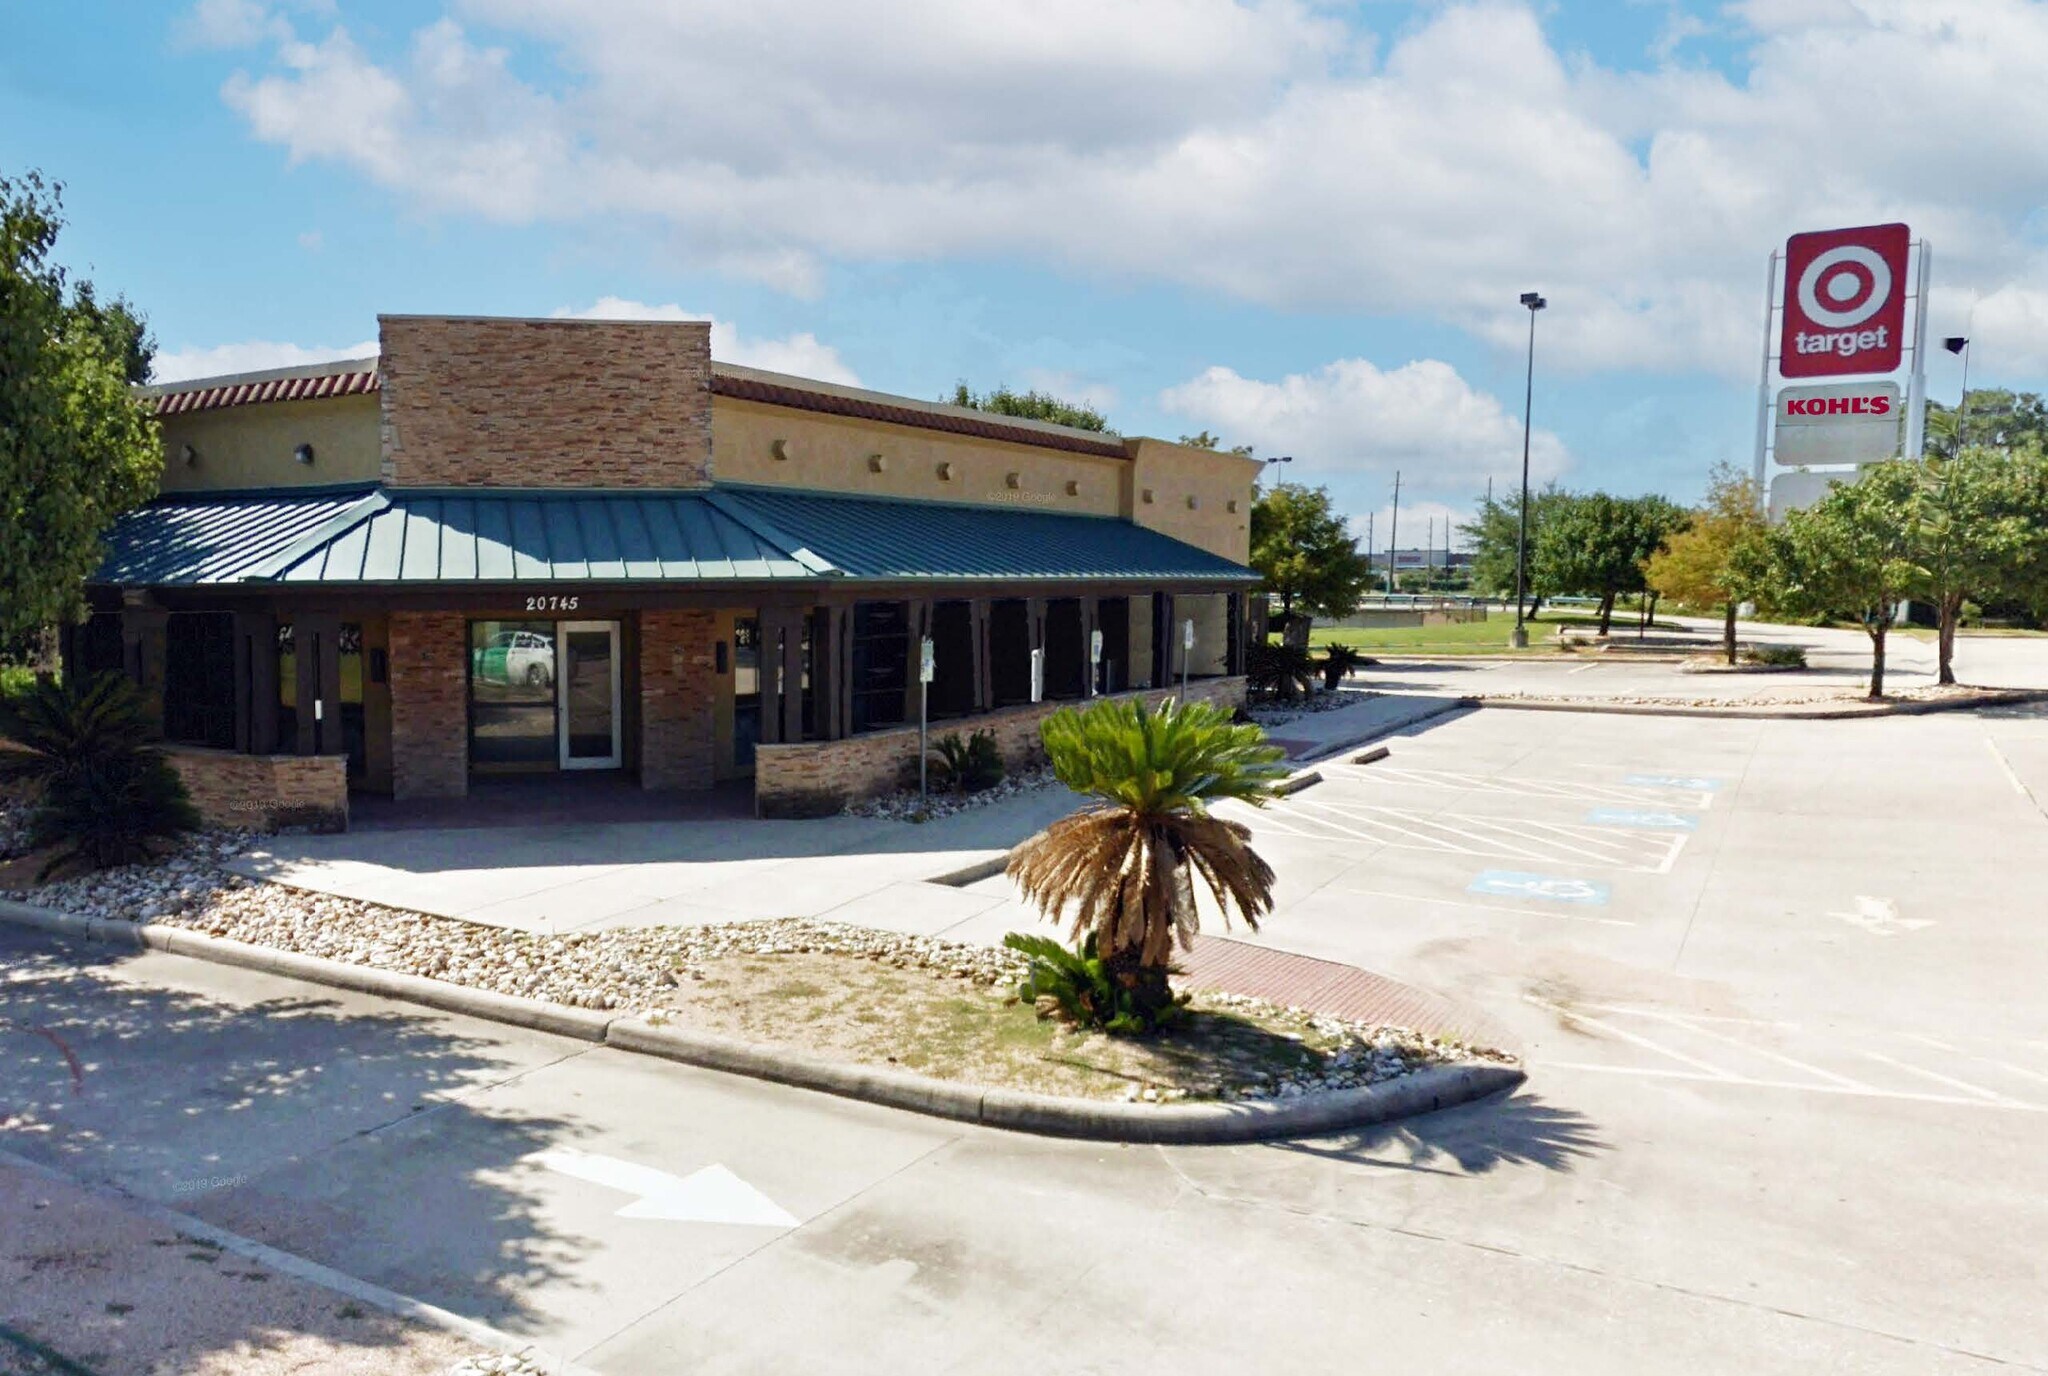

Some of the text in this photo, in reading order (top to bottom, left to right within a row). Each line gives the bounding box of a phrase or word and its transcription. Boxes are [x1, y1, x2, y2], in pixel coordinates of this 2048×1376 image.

[1795, 325, 1888, 357] target
[1787, 396, 1890, 416] KOHL'S
[526, 596, 579, 611] 20745
